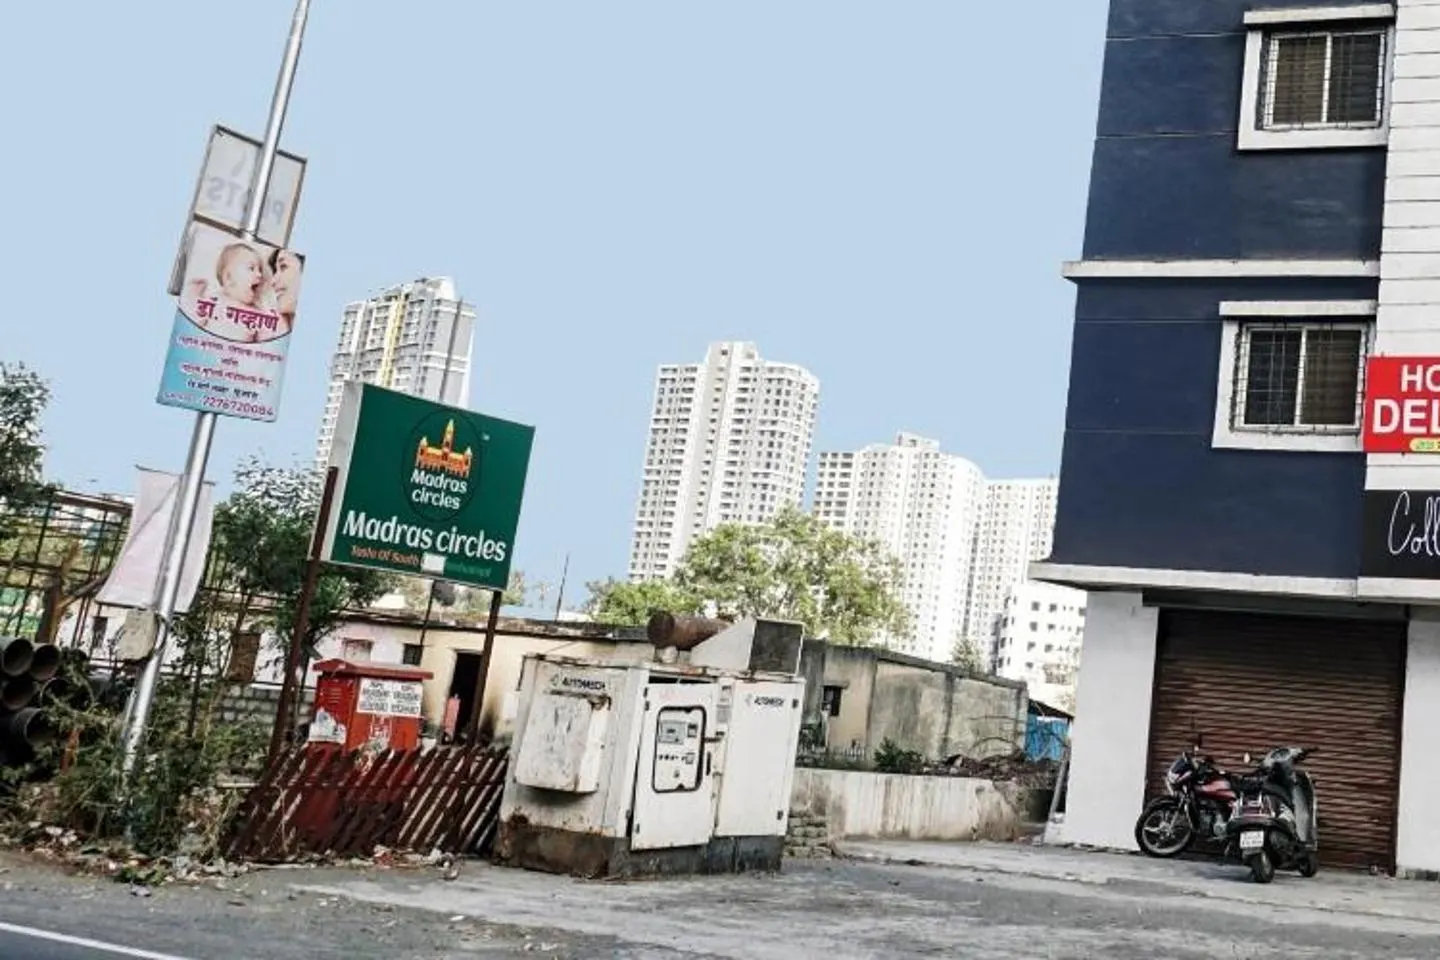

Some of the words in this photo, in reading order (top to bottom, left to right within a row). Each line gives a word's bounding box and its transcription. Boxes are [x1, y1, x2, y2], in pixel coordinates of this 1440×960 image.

[196, 297, 218, 320] डॉ.
[411, 469, 467, 493] Madras
[412, 487, 461, 510] circles
[342, 510, 433, 549] Madras
[436, 526, 507, 562] circles
